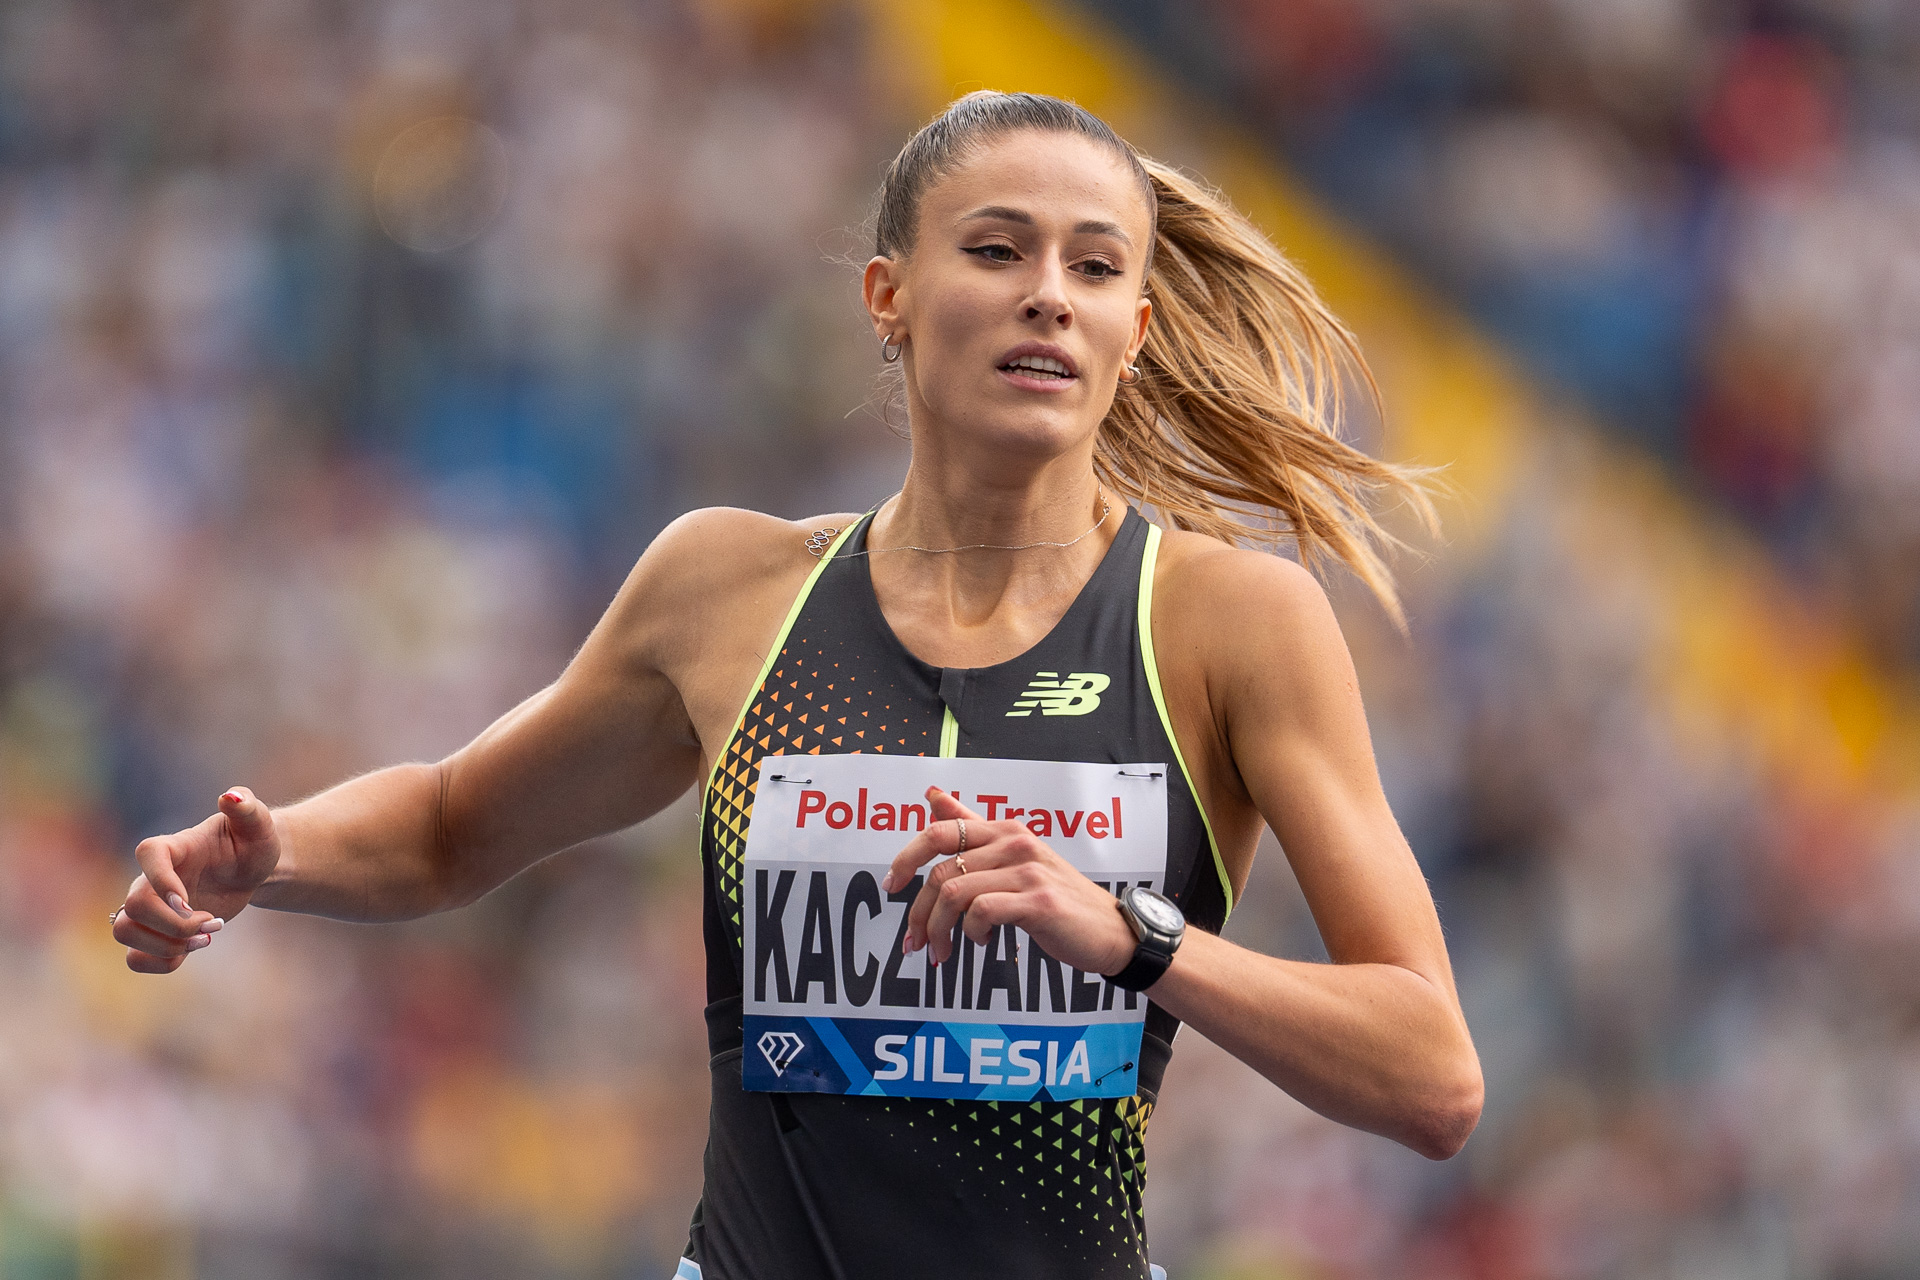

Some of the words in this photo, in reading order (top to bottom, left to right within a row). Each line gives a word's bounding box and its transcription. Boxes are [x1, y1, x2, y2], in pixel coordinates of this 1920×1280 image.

[796, 787, 960, 832] Polan
[753, 868, 1153, 1014] KACZMA
[874, 1034, 1091, 1087] SILESIA
